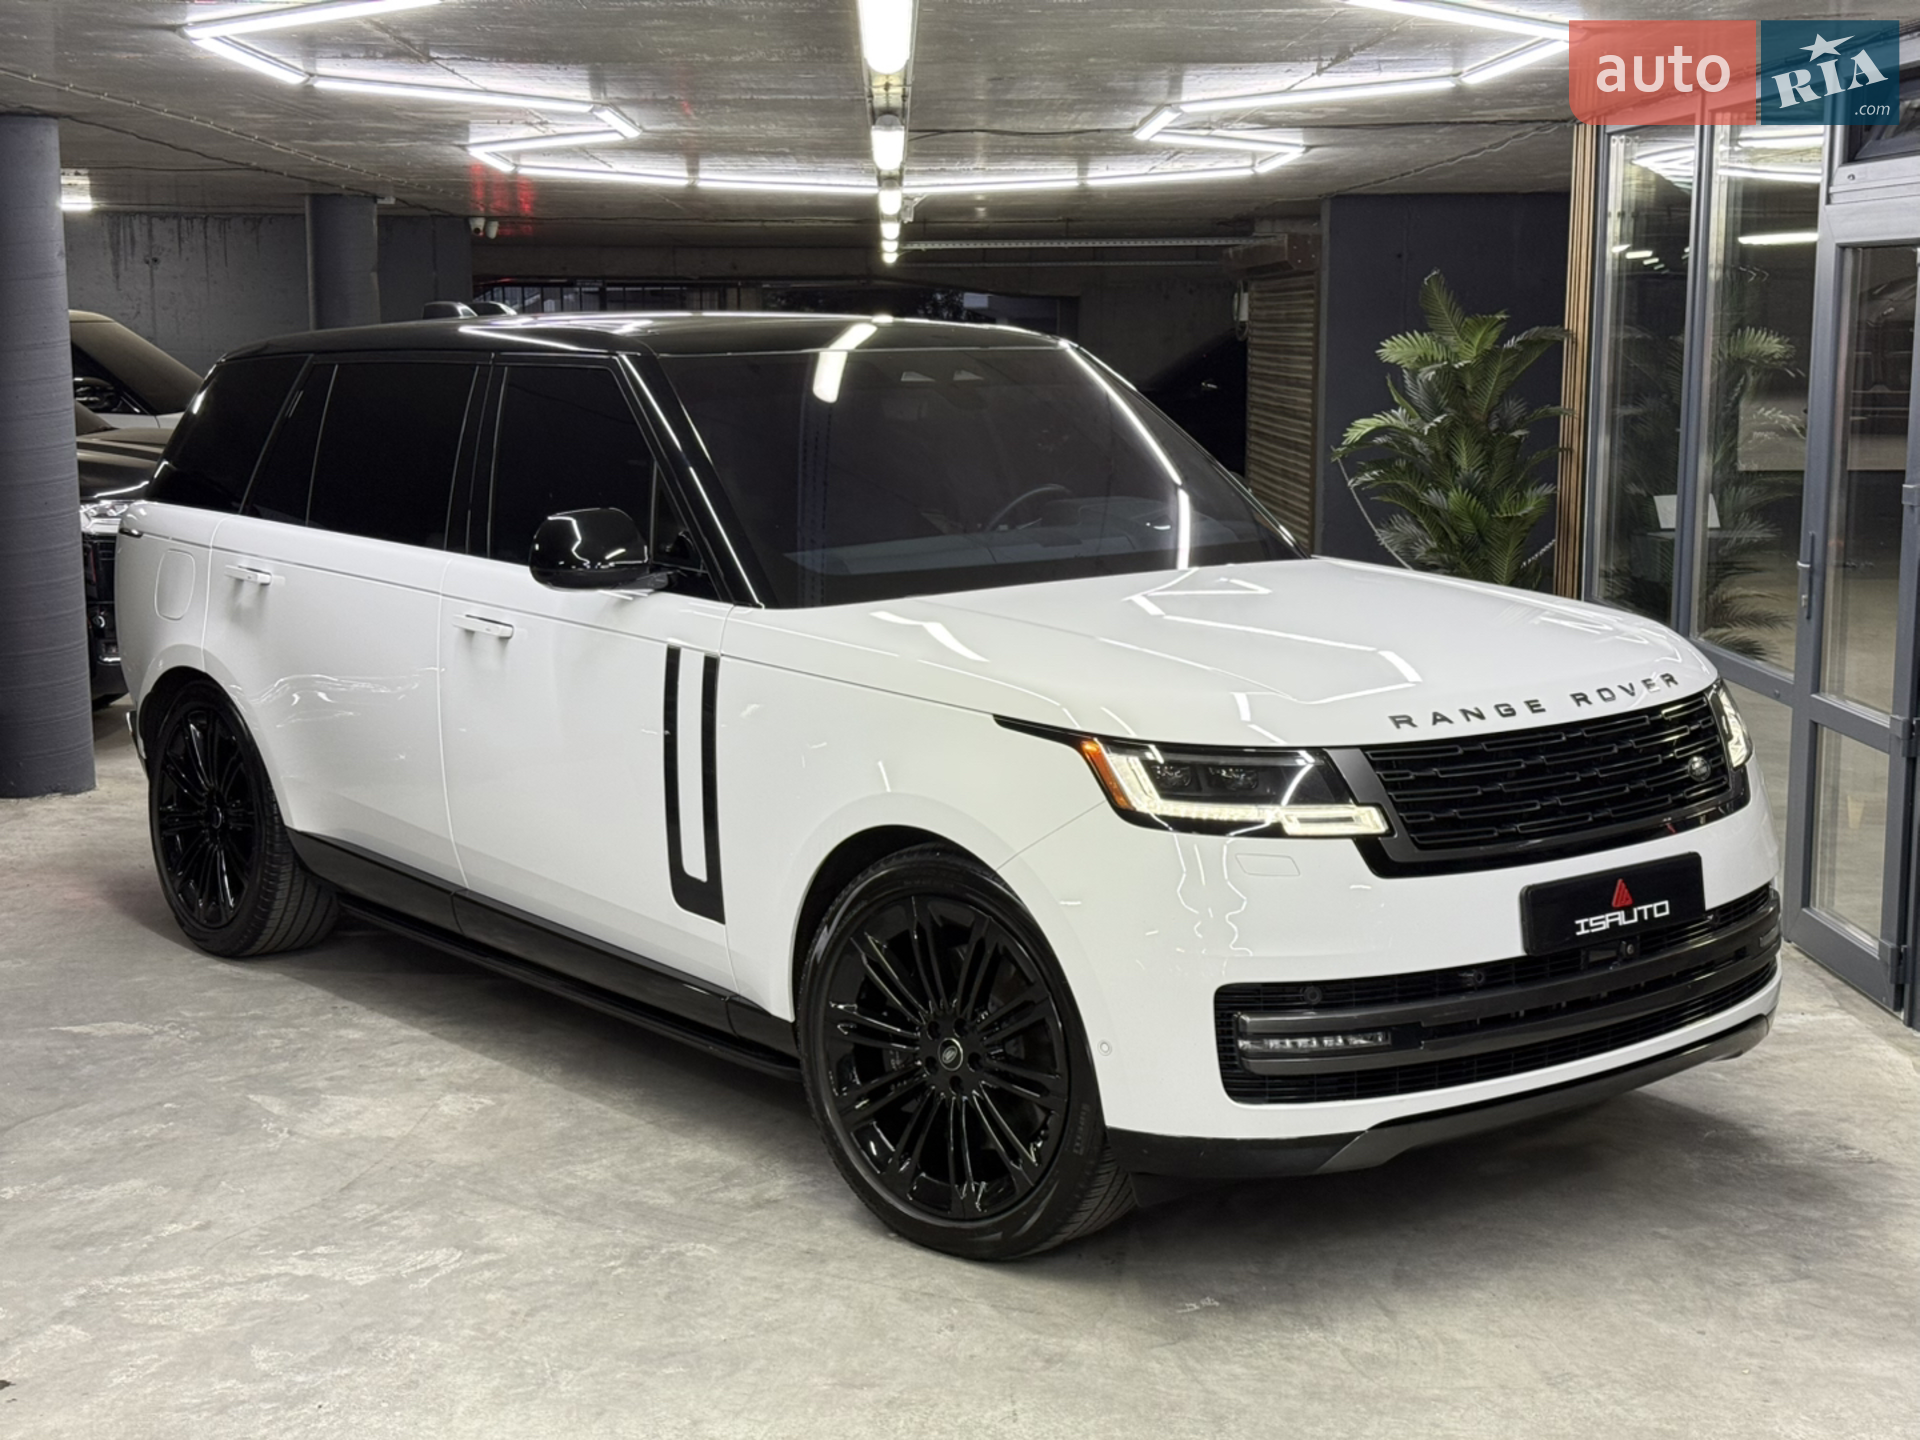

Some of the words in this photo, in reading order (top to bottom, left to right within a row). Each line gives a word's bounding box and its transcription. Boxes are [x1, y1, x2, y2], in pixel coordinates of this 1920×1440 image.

[1388, 698, 1547, 730] RANGE
[1569, 672, 1680, 708] ROVER
[1574, 899, 1671, 936] ISAUTO
